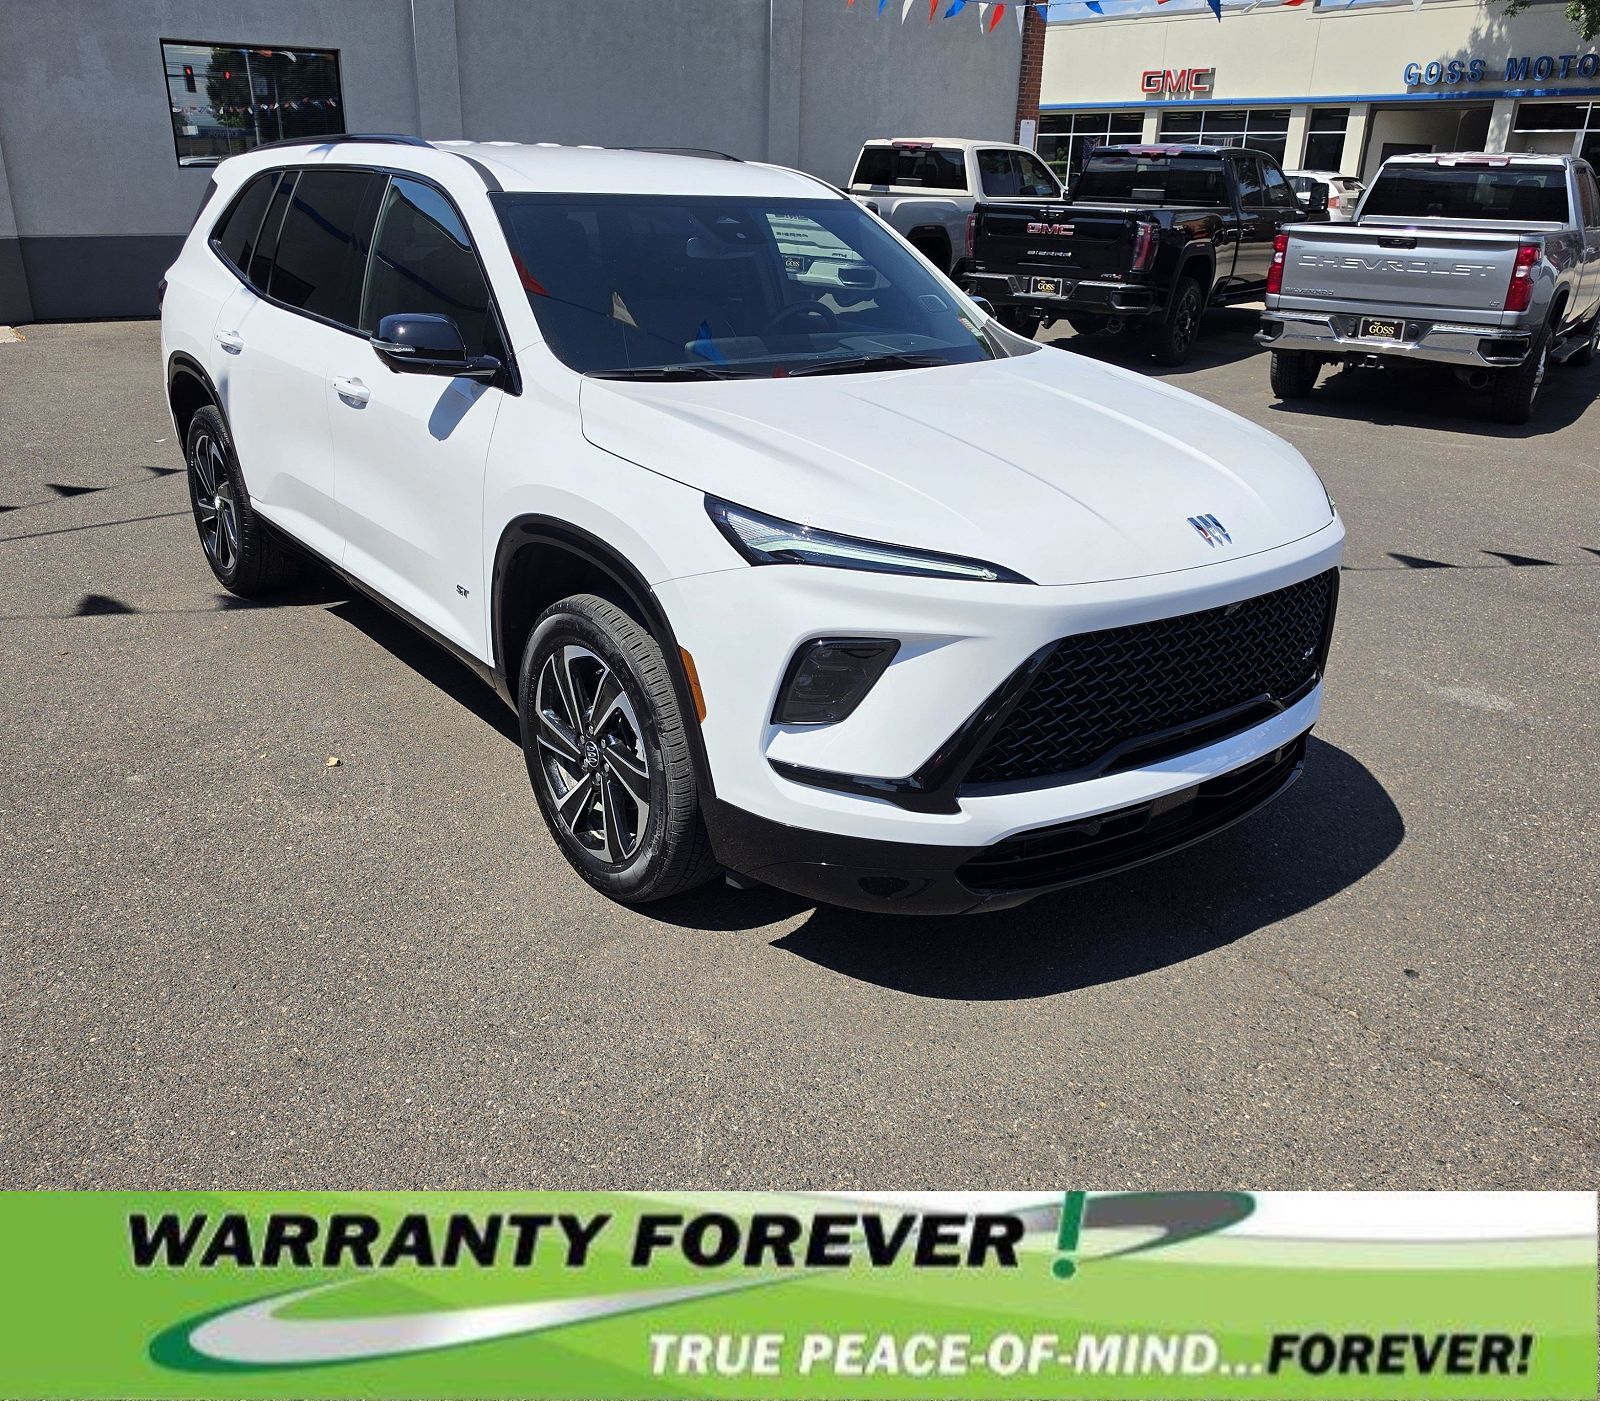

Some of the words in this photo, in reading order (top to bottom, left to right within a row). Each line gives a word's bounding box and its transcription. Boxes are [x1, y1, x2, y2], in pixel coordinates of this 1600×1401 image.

[1404, 59, 1486, 86] GOSS
[1504, 53, 1600, 82] MOTO
[1141, 68, 1210, 93] GMC
[1027, 222, 1075, 236] GMC
[1298, 255, 1496, 276] CHEVROLET
[1037, 282, 1055, 290] GOSS
[1369, 324, 1395, 335] GOSS
